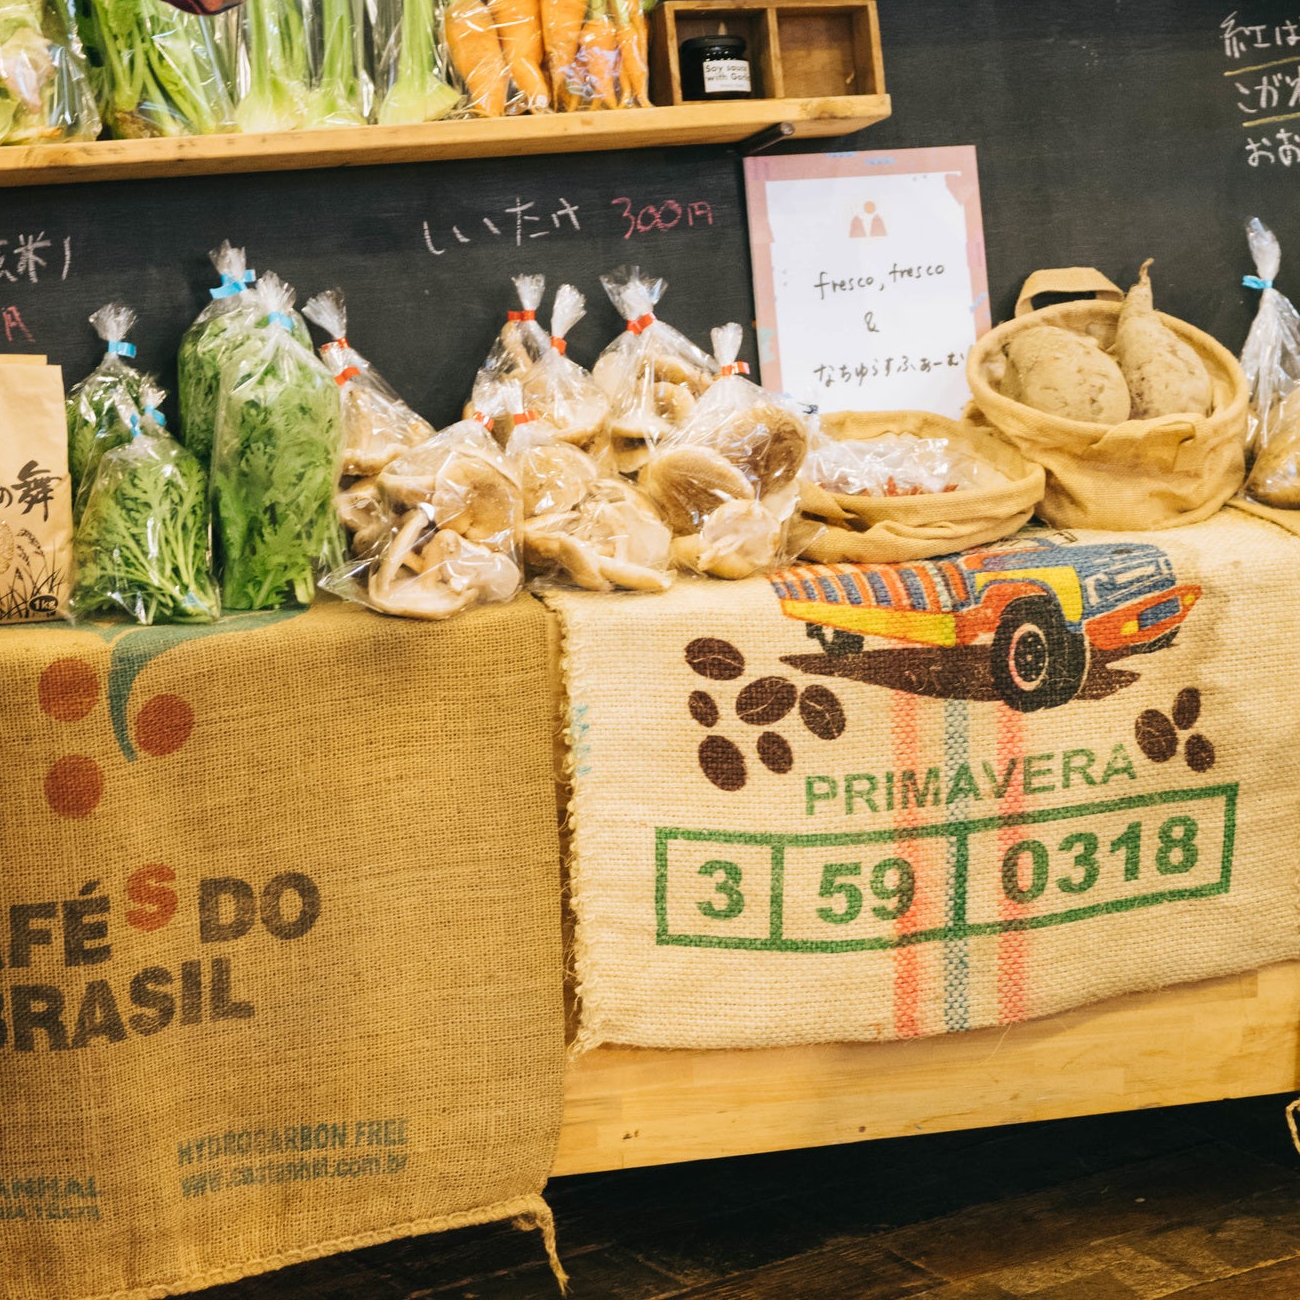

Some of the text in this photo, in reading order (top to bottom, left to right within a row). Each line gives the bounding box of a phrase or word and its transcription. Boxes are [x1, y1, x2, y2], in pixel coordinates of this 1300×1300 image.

[422, 196, 714, 256] しいたけ 300円
[863, 311, 880, 333] &
[804, 744, 1138, 817] PRIMAVERA
[696, 815, 1200, 924] 3 59 0318
[199, 871, 322, 944] DO
[178, 1118, 409, 1165] HYDROCARBON FREE
